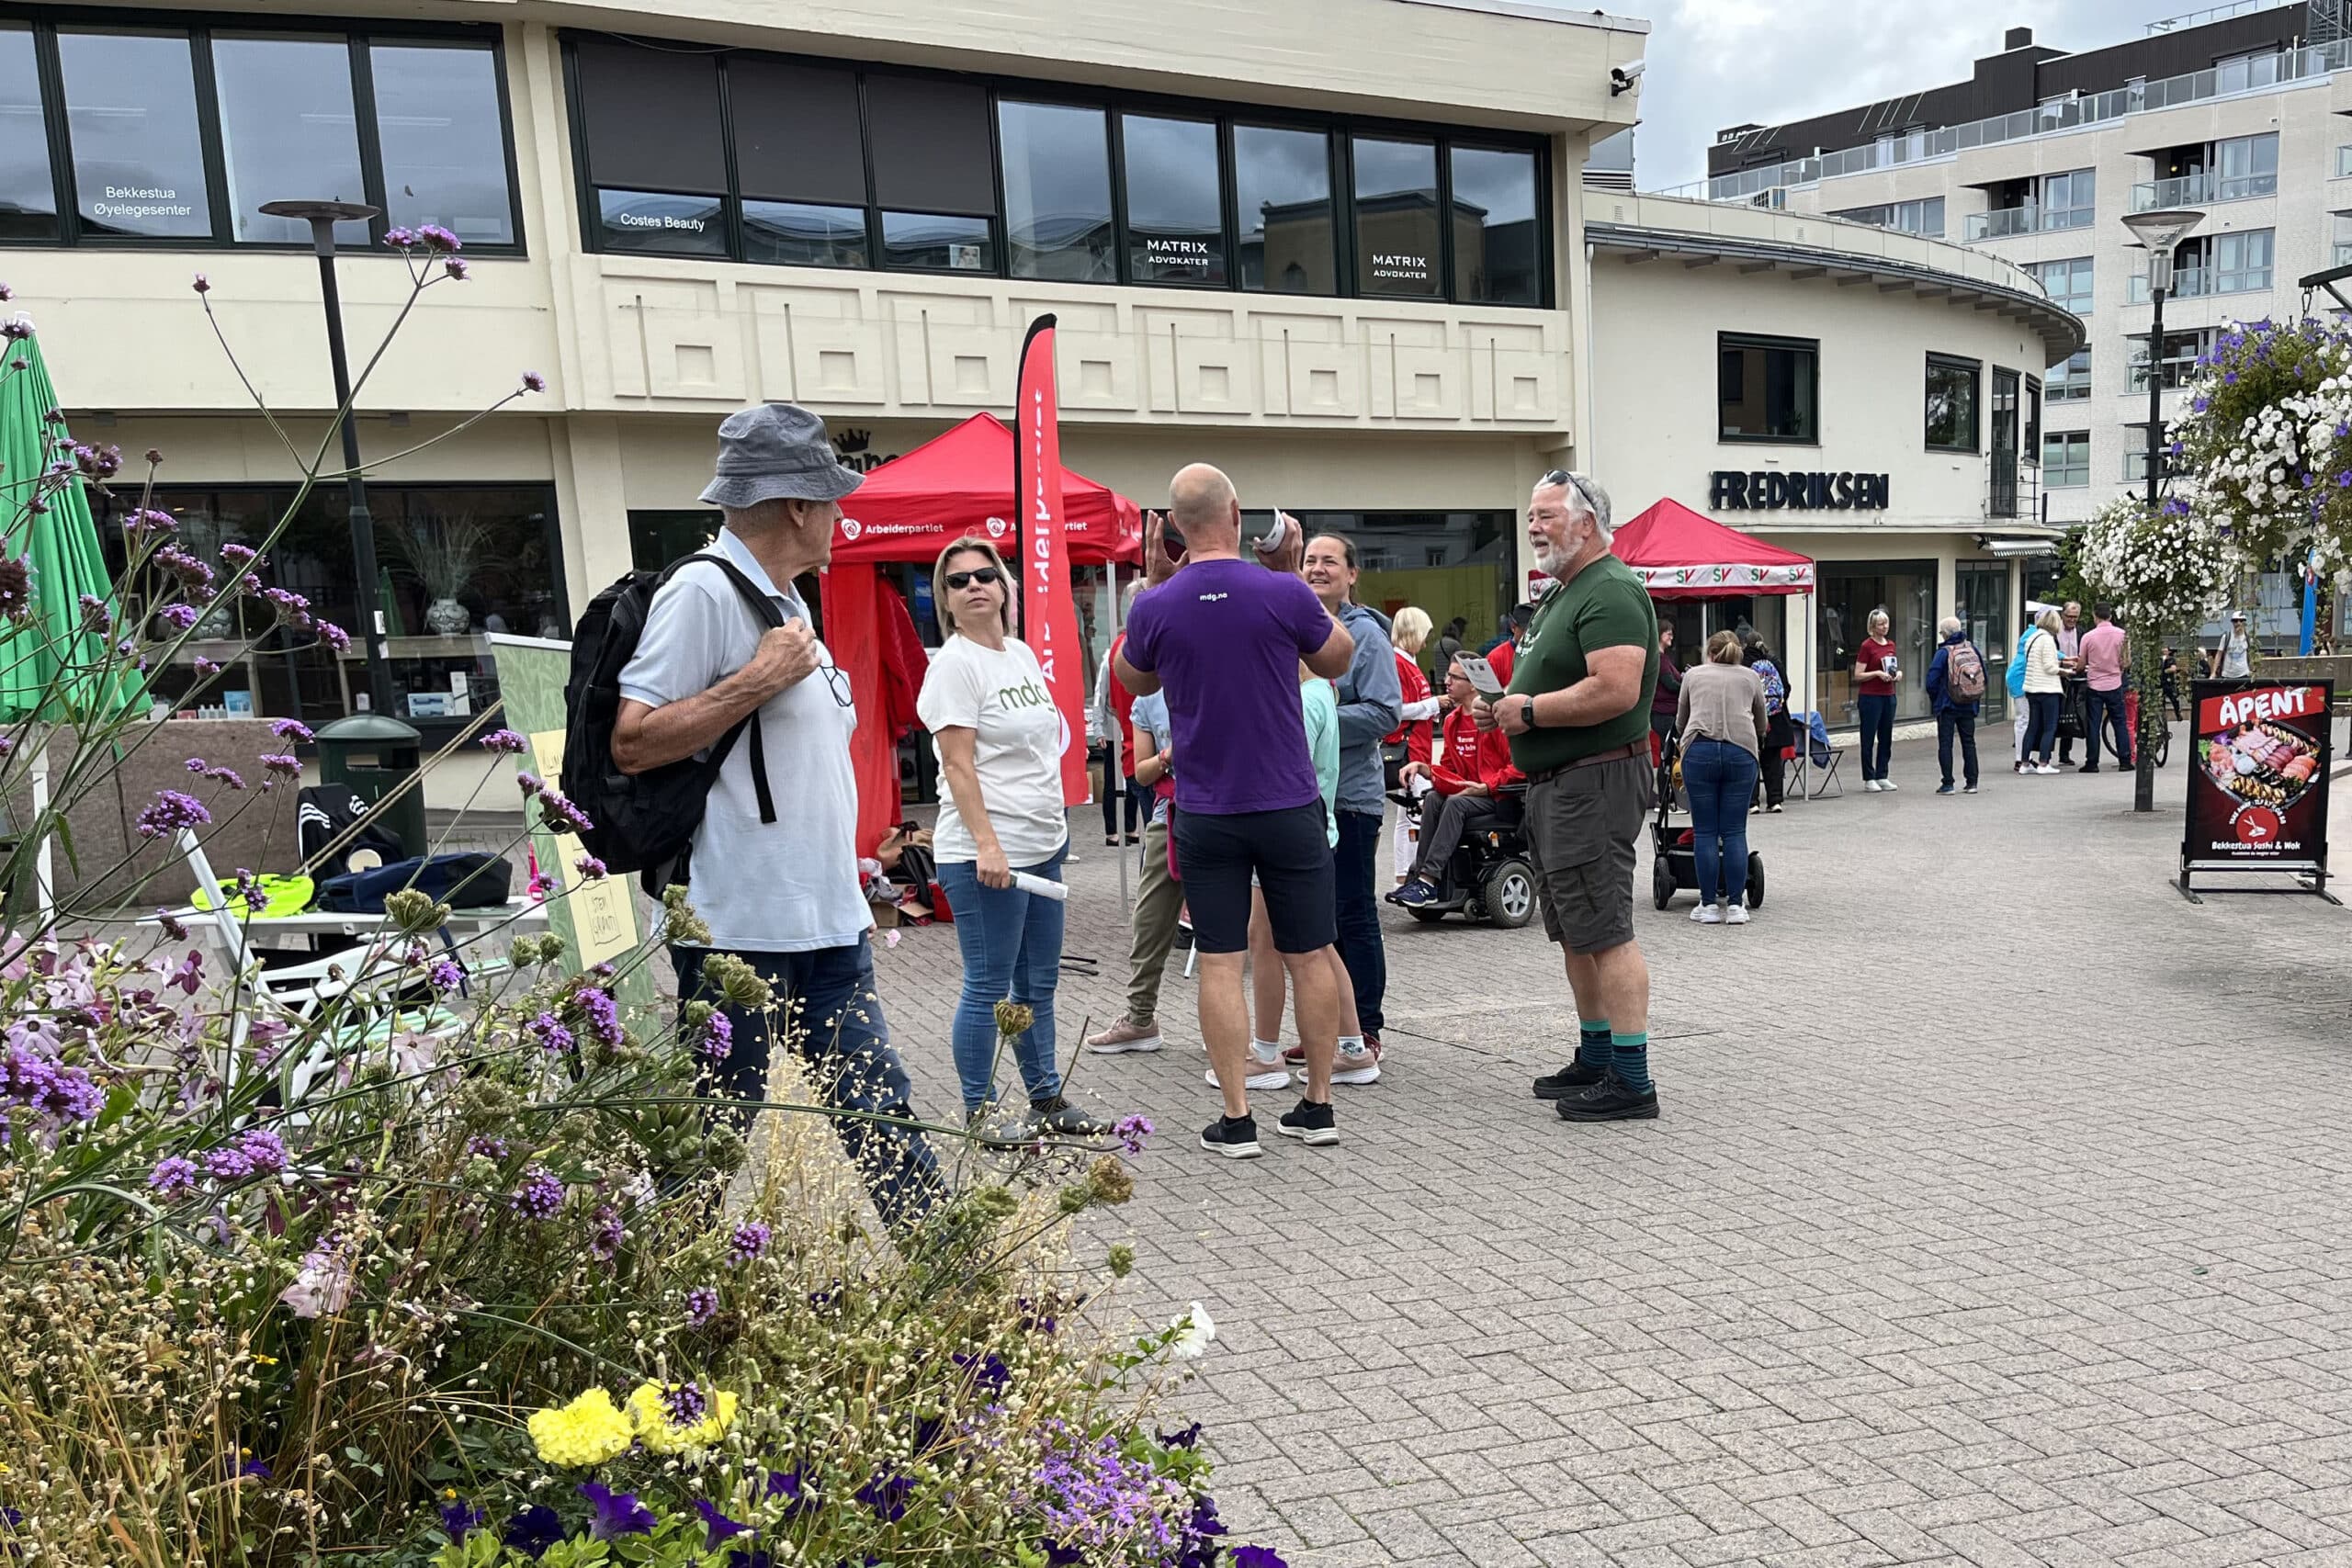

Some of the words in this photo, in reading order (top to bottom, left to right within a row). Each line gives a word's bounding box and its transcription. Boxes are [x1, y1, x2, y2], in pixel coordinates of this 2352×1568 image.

[106, 186, 175, 198] Bekkestua
[94, 203, 191, 218] Øyelegesenter
[620, 213, 662, 227] Costes
[664, 216, 705, 232] Beauty
[1147, 239, 1208, 254] MATRIX
[1148, 256, 1209, 266] ADVOKATER
[1373, 254, 1427, 267] MATRIX
[1373, 269, 1427, 279] ADVOKATER
[1710, 470, 1890, 510] FREDRIKSEN
[865, 523, 944, 535] Arbeiderpartiet
[1636, 570, 1657, 584] SV
[1676, 569, 1696, 583] SV
[1713, 568, 1732, 582] SV
[1751, 568, 1770, 581] SV
[1789, 568, 1806, 581] SV
[1199, 592, 1228, 602] mdg.no
[2219, 686, 2309, 727] ÅPENT
[2211, 841, 2252, 850] Bekkestua
[2253, 841, 2274, 850] Sushi
[2275, 841, 2282, 850] &
[2284, 841, 2301, 850] Wok
